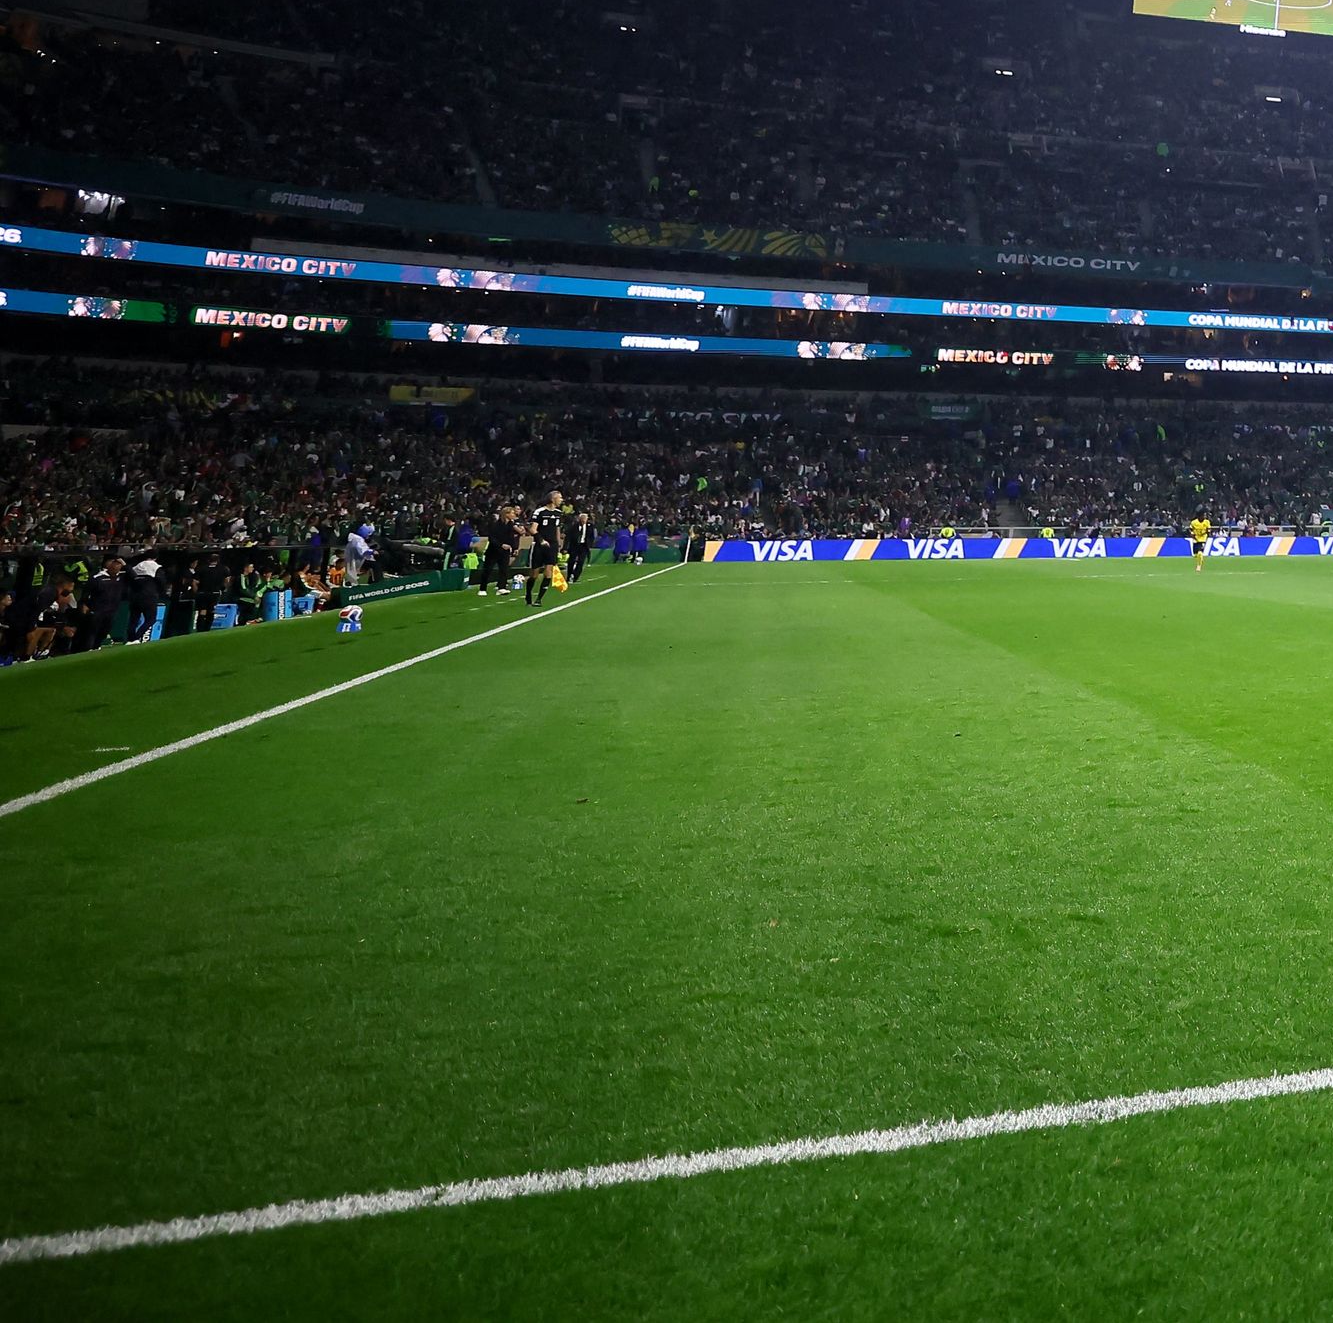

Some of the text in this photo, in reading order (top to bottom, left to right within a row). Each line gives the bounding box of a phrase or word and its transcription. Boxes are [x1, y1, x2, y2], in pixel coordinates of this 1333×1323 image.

[270, 191, 365, 215] #FIFAWorldCup
[205, 250, 356, 276] MEXICO CITY
[1090, 257, 1140, 272] CITY
[942, 301, 1058, 318] MEXICO CITY
[195, 308, 348, 333] MEXICO CITY
[1188, 314, 1224, 327] COPA
[1224, 316, 1280, 329] MUNDIAL
[1299, 319, 1316, 331] LA
[938, 348, 1053, 365] MEXICO CITY
[1185, 359, 1220, 371] COPA
[1221, 360, 1278, 373] MUNDIAL
[1279, 362, 1296, 373] DE
[1297, 362, 1313, 374] LA
[748, 541, 814, 562] VISA
[904, 539, 964, 560] VISA
[1051, 538, 1106, 558] VISA
[348, 592, 364, 601] FIFA
[364, 587, 390, 598] WORLD
[390, 584, 404, 593] CUP
